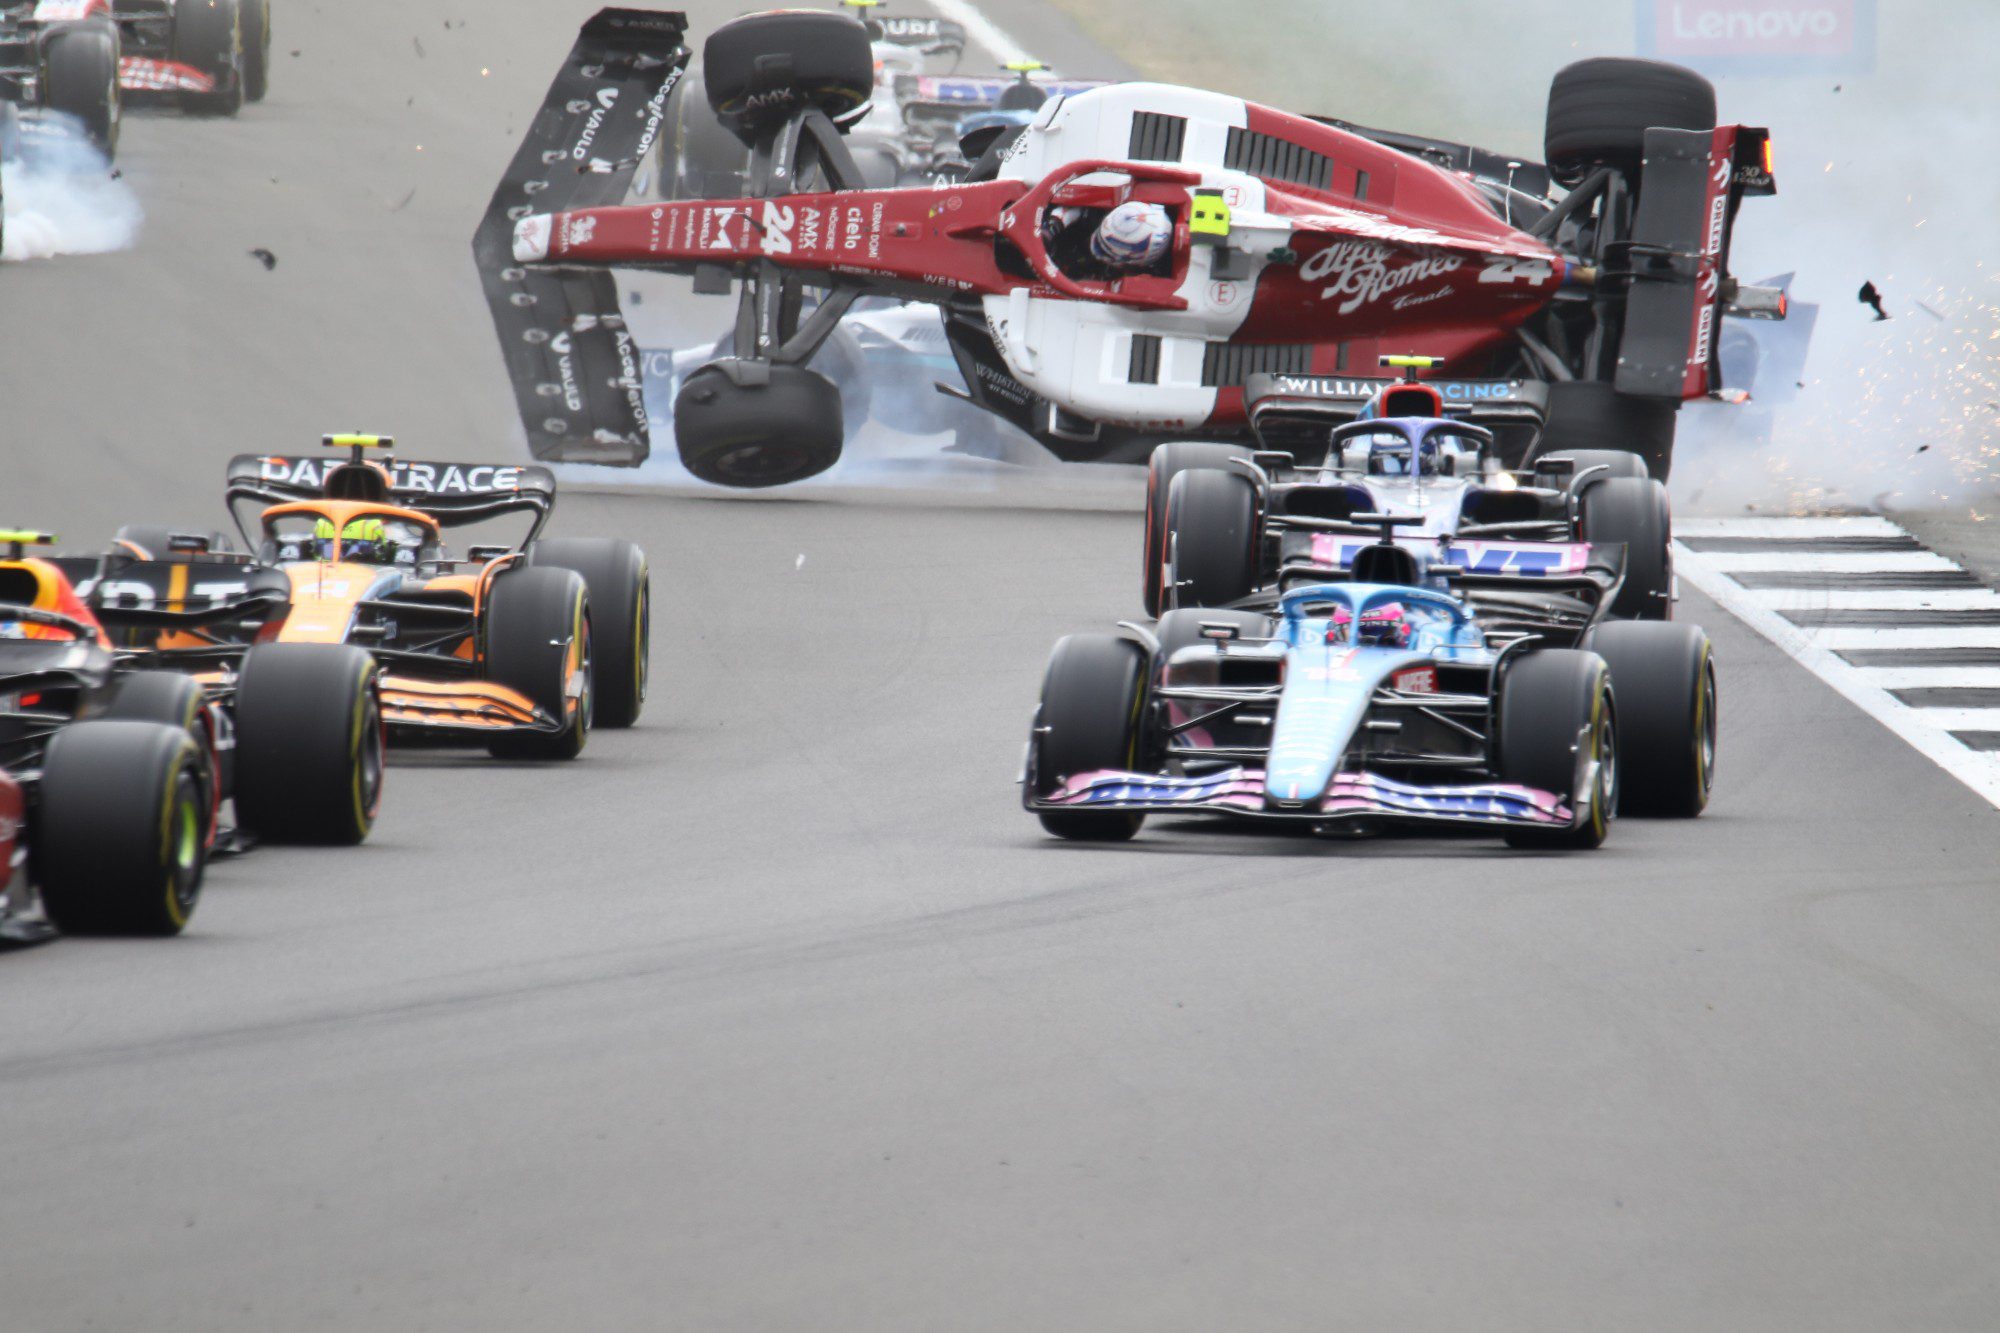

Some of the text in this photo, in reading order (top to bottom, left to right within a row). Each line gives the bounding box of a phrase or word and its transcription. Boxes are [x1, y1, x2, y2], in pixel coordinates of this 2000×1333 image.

[1673, 4, 1838, 38] Lenovo
[573, 107, 603, 160] VAULD
[700, 207, 711, 250] MARELLI
[760, 201, 795, 255] 24
[804, 207, 821, 250] AMX
[844, 207, 864, 250] cielo
[868, 234, 880, 258] DOMI
[923, 273, 956, 288] WEB
[1338, 255, 1465, 315] Romeo
[1478, 256, 1553, 286] 24
[557, 358, 580, 412] VAULD
[1284, 377, 1510, 399] WILLIA ACING
[260, 457, 519, 493] DATRACE
